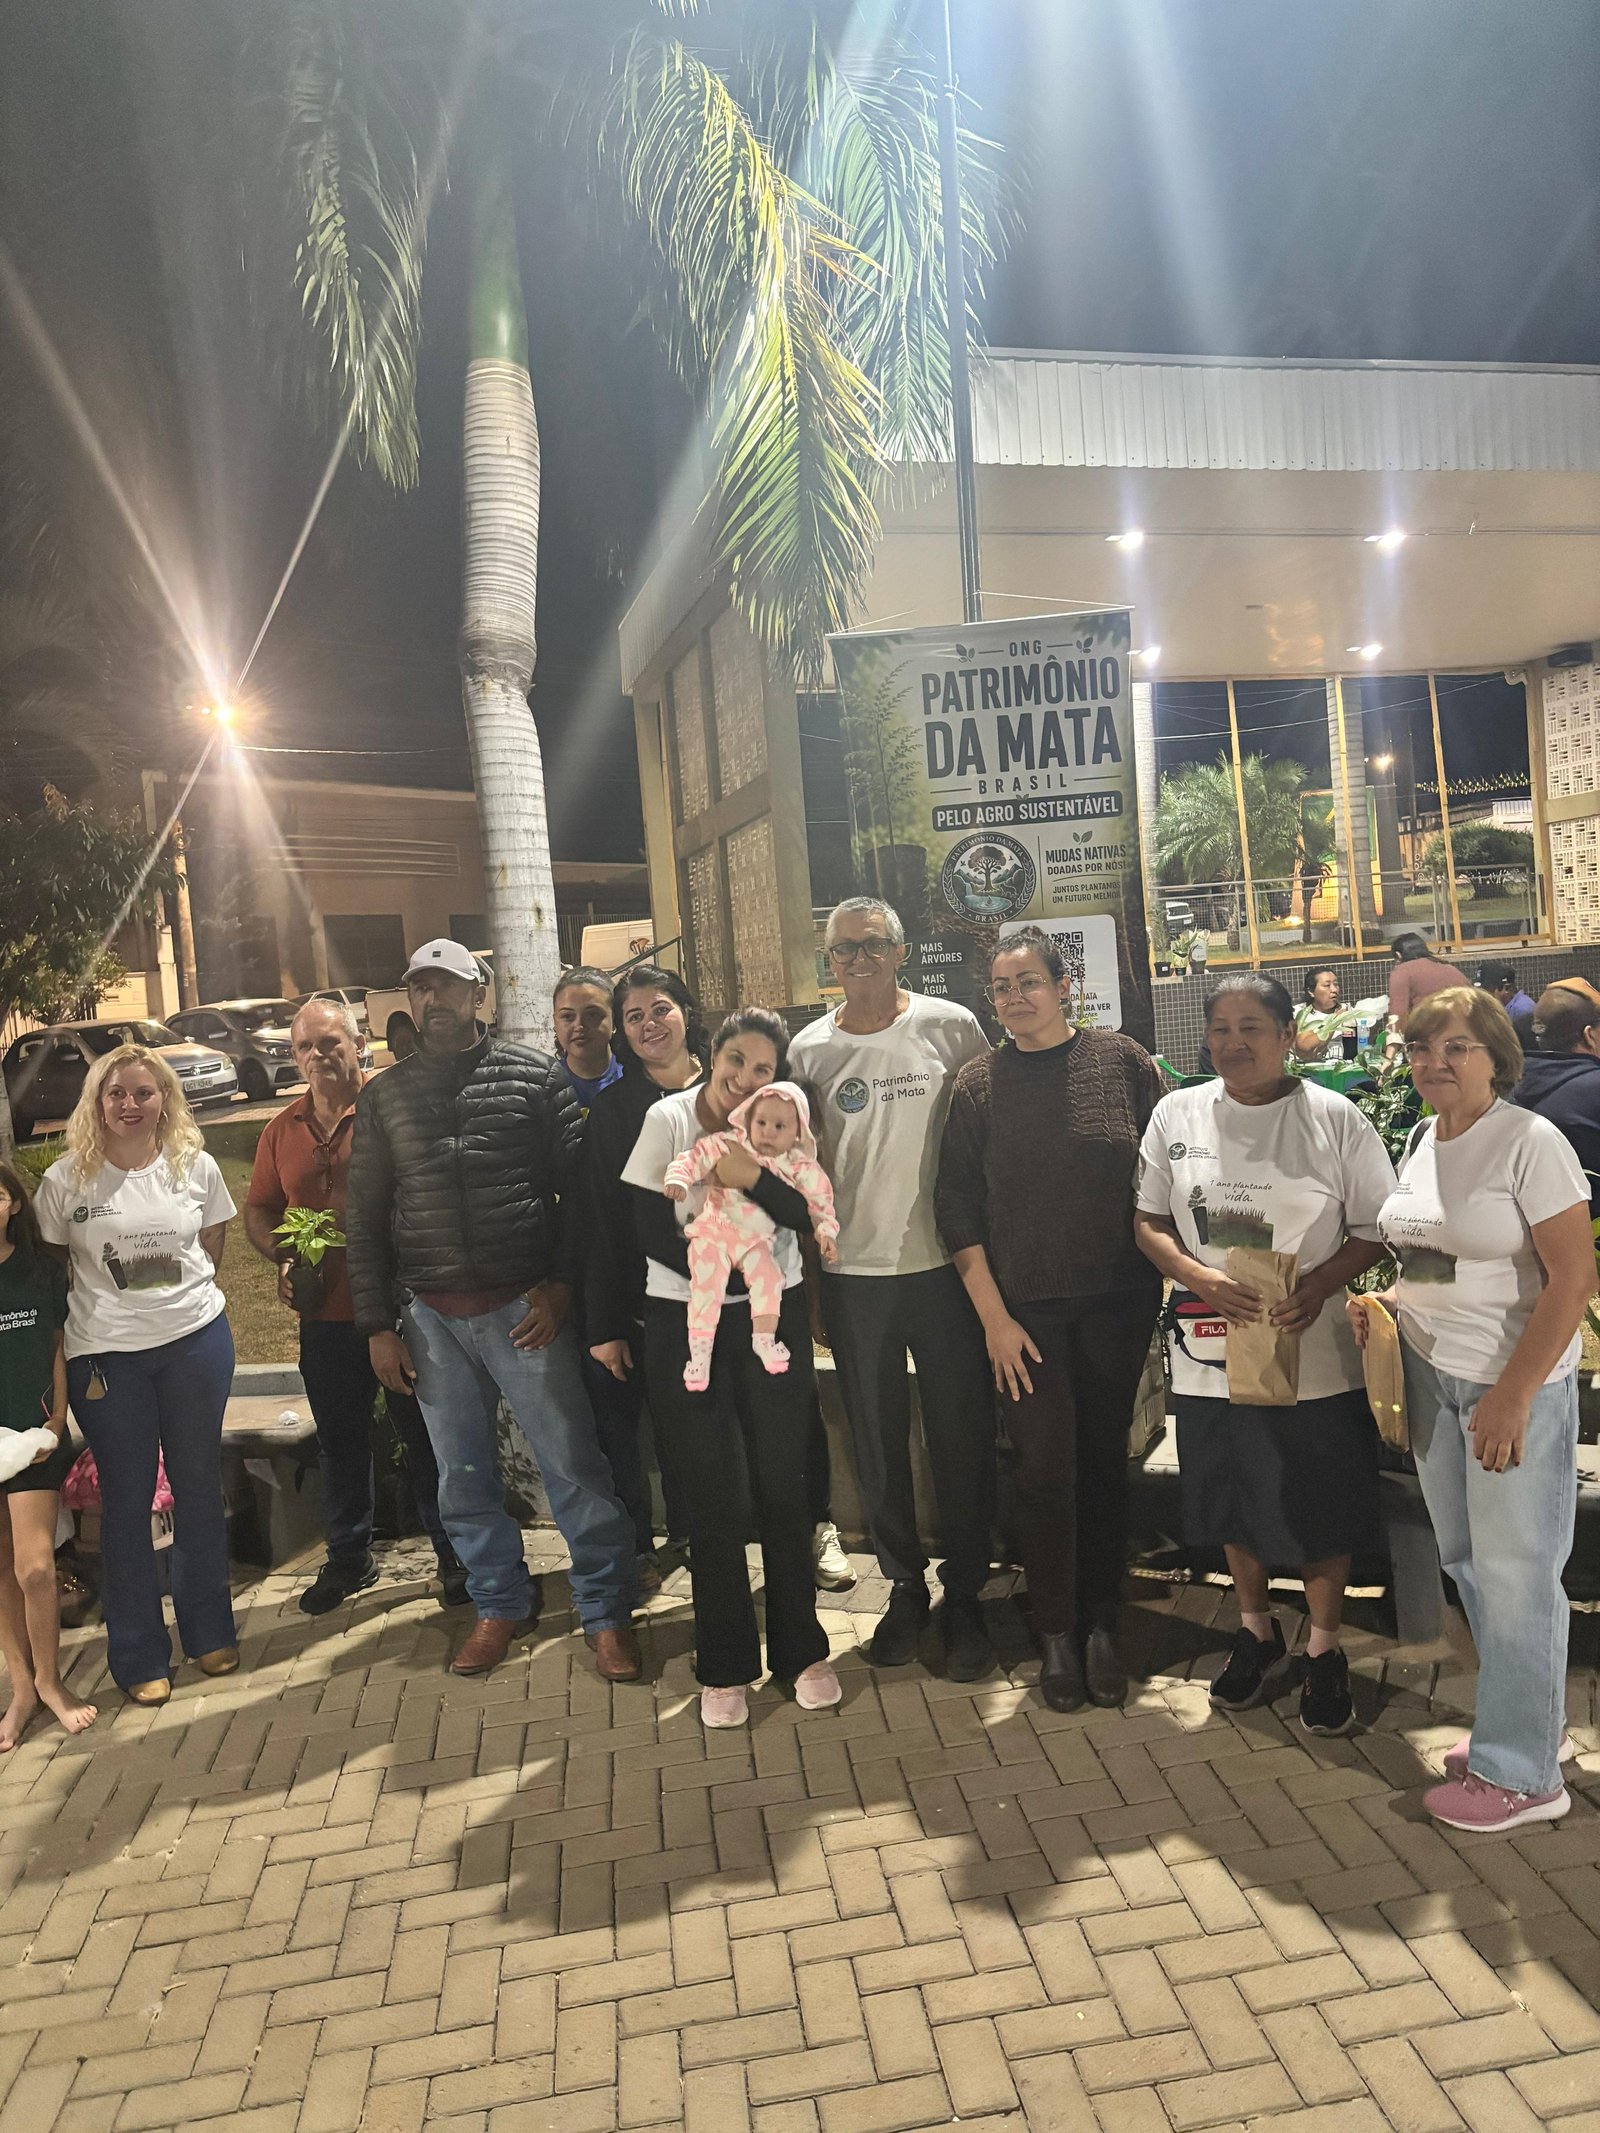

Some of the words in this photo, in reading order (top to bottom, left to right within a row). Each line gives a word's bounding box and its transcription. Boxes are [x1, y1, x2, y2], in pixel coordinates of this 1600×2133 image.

[1009, 639, 1042, 656] ONG
[921, 655, 1120, 716] PATRIMÔNIO
[925, 718, 987, 779] DA
[997, 706, 1122, 773] MATA
[978, 773, 1067, 795] BRASIL
[937, 808, 971, 828] PELO
[975, 804, 1014, 824] AGRO
[1019, 795, 1119, 820] SUSTENTÁVEL
[1045, 848, 1082, 864] MUDAS
[1084, 844, 1127, 861] NATIVAS
[1047, 864, 1083, 876] DOADAS
[1085, 863, 1103, 873] POR
[1105, 859, 1127, 871] NÓS!
[1053, 884, 1079, 894] JUNTOS
[1081, 881, 1120, 892] PLANTAMOS
[1052, 895, 1063, 904] UM
[1065, 893, 1092, 903] FUTURO
[1093, 891, 1121, 901] MELHOR
[974, 912, 1009, 923] BRASIL
[920, 942, 943, 953] MAIS
[921, 952, 963, 965] ÁRVORES
[922, 973, 945, 985] MAIS
[923, 983, 948, 995] ÁGUA
[1076, 1003, 1096, 1012] PRA
[1097, 1002, 1111, 1011] VER
[872, 1072, 930, 1089] Patrimônio
[881, 1091, 894, 1102] da
[897, 1087, 926, 1099] Mata
[1232, 1181, 1273, 1191] plantando
[1224, 1189, 1253, 1202] vida.
[140, 1228, 177, 1239] plantando
[134, 1237, 161, 1250] vida.
[1200, 1325, 1226, 1335] FILA
